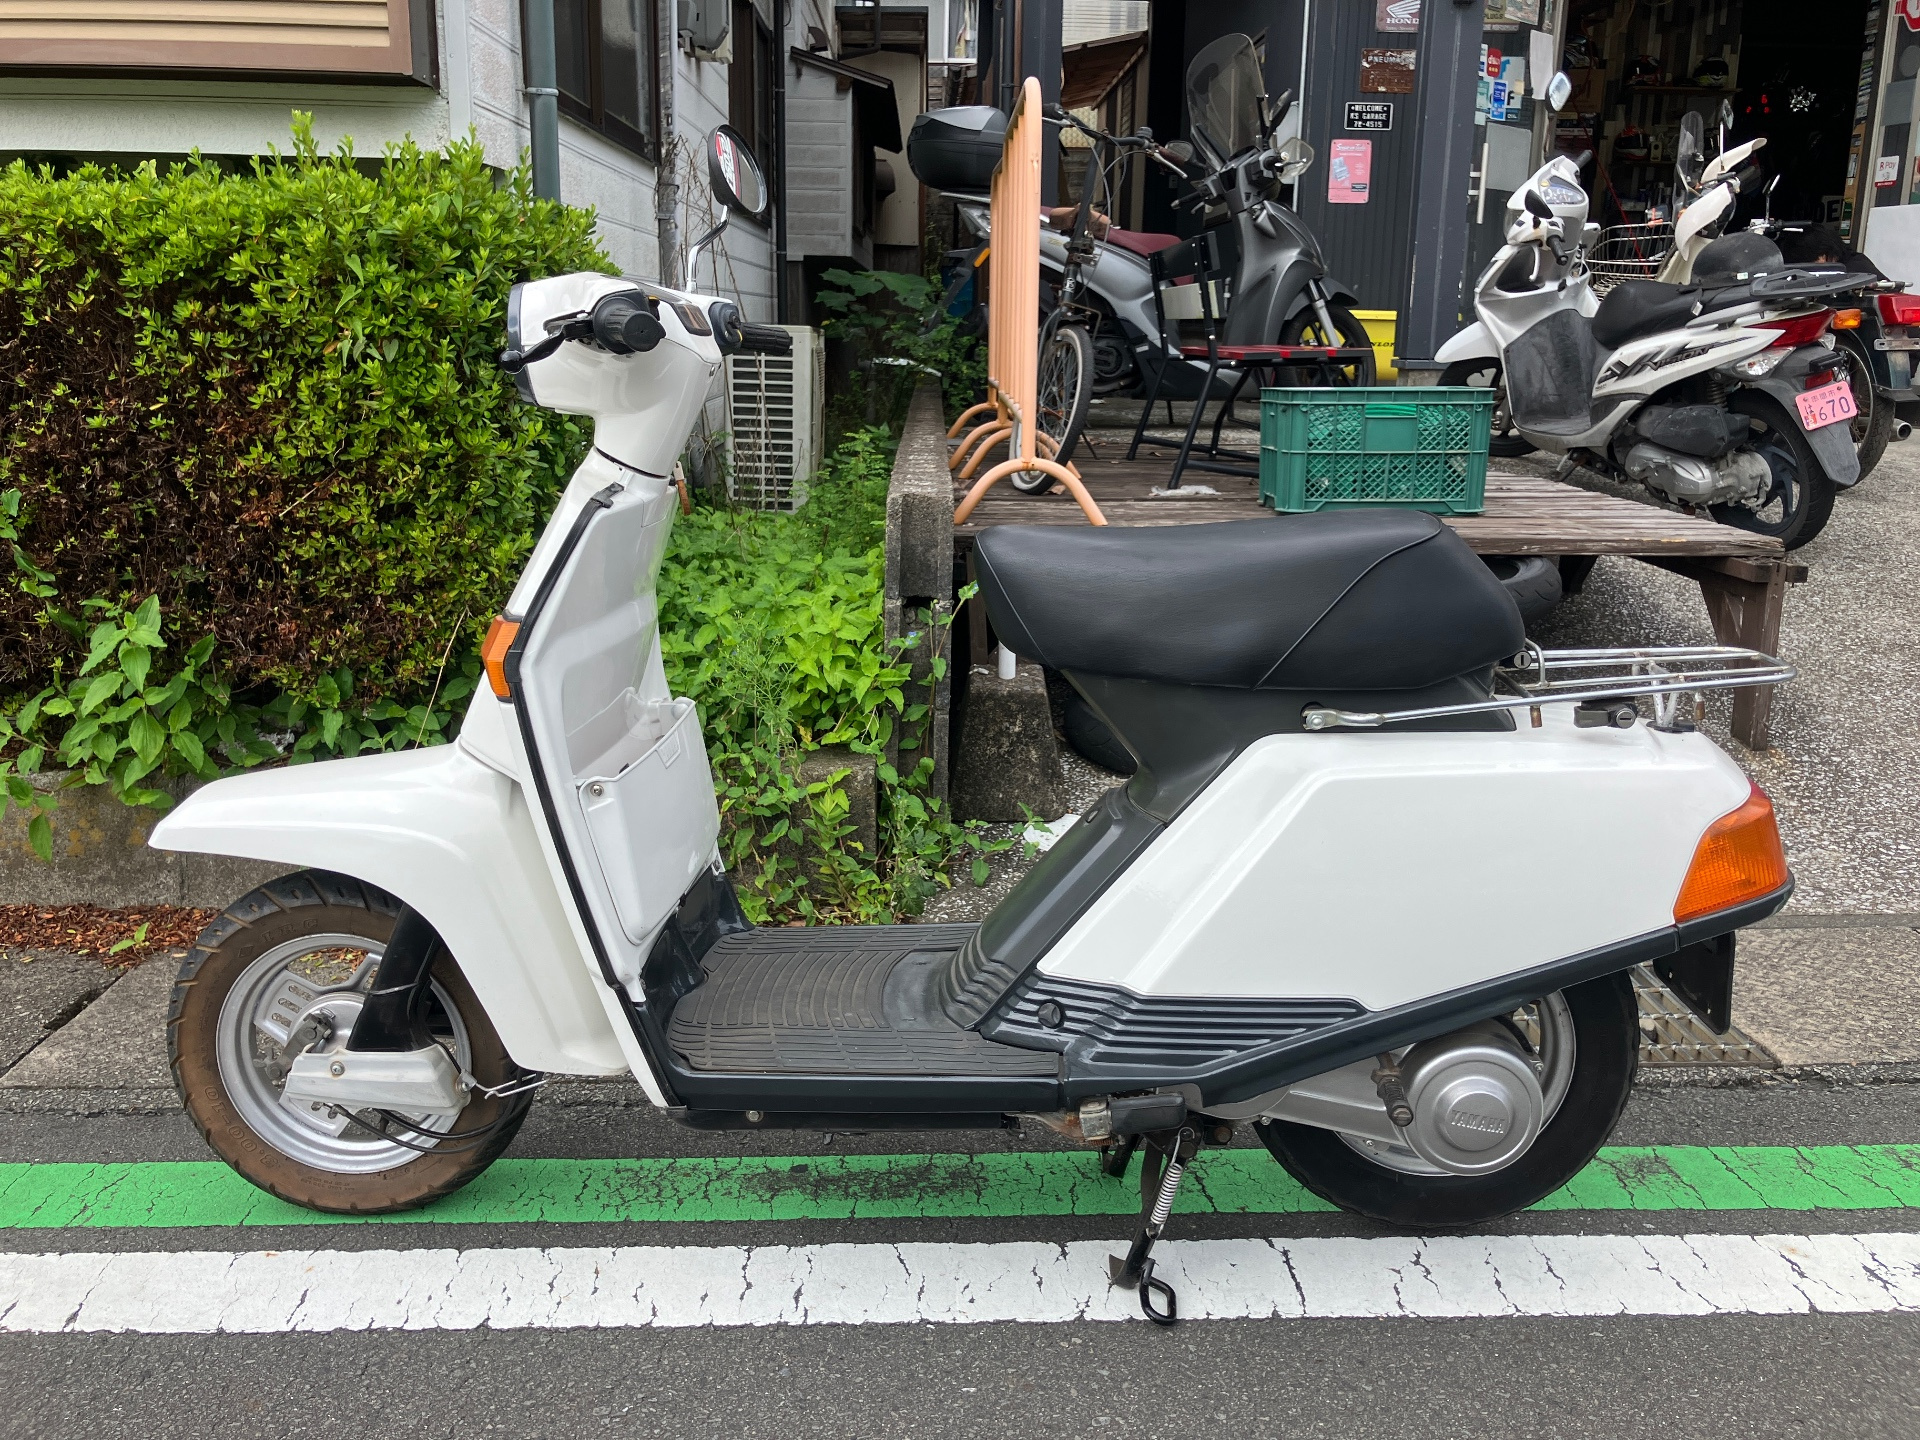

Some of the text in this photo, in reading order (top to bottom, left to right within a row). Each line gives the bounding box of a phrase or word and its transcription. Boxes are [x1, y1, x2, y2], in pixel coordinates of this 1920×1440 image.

[1385, 17, 1419, 25] HOND
[1354, 104, 1384, 112] WELCOME
[1818, 396, 1851, 421] 670
[1451, 1109, 1505, 1134] YAMAHA
